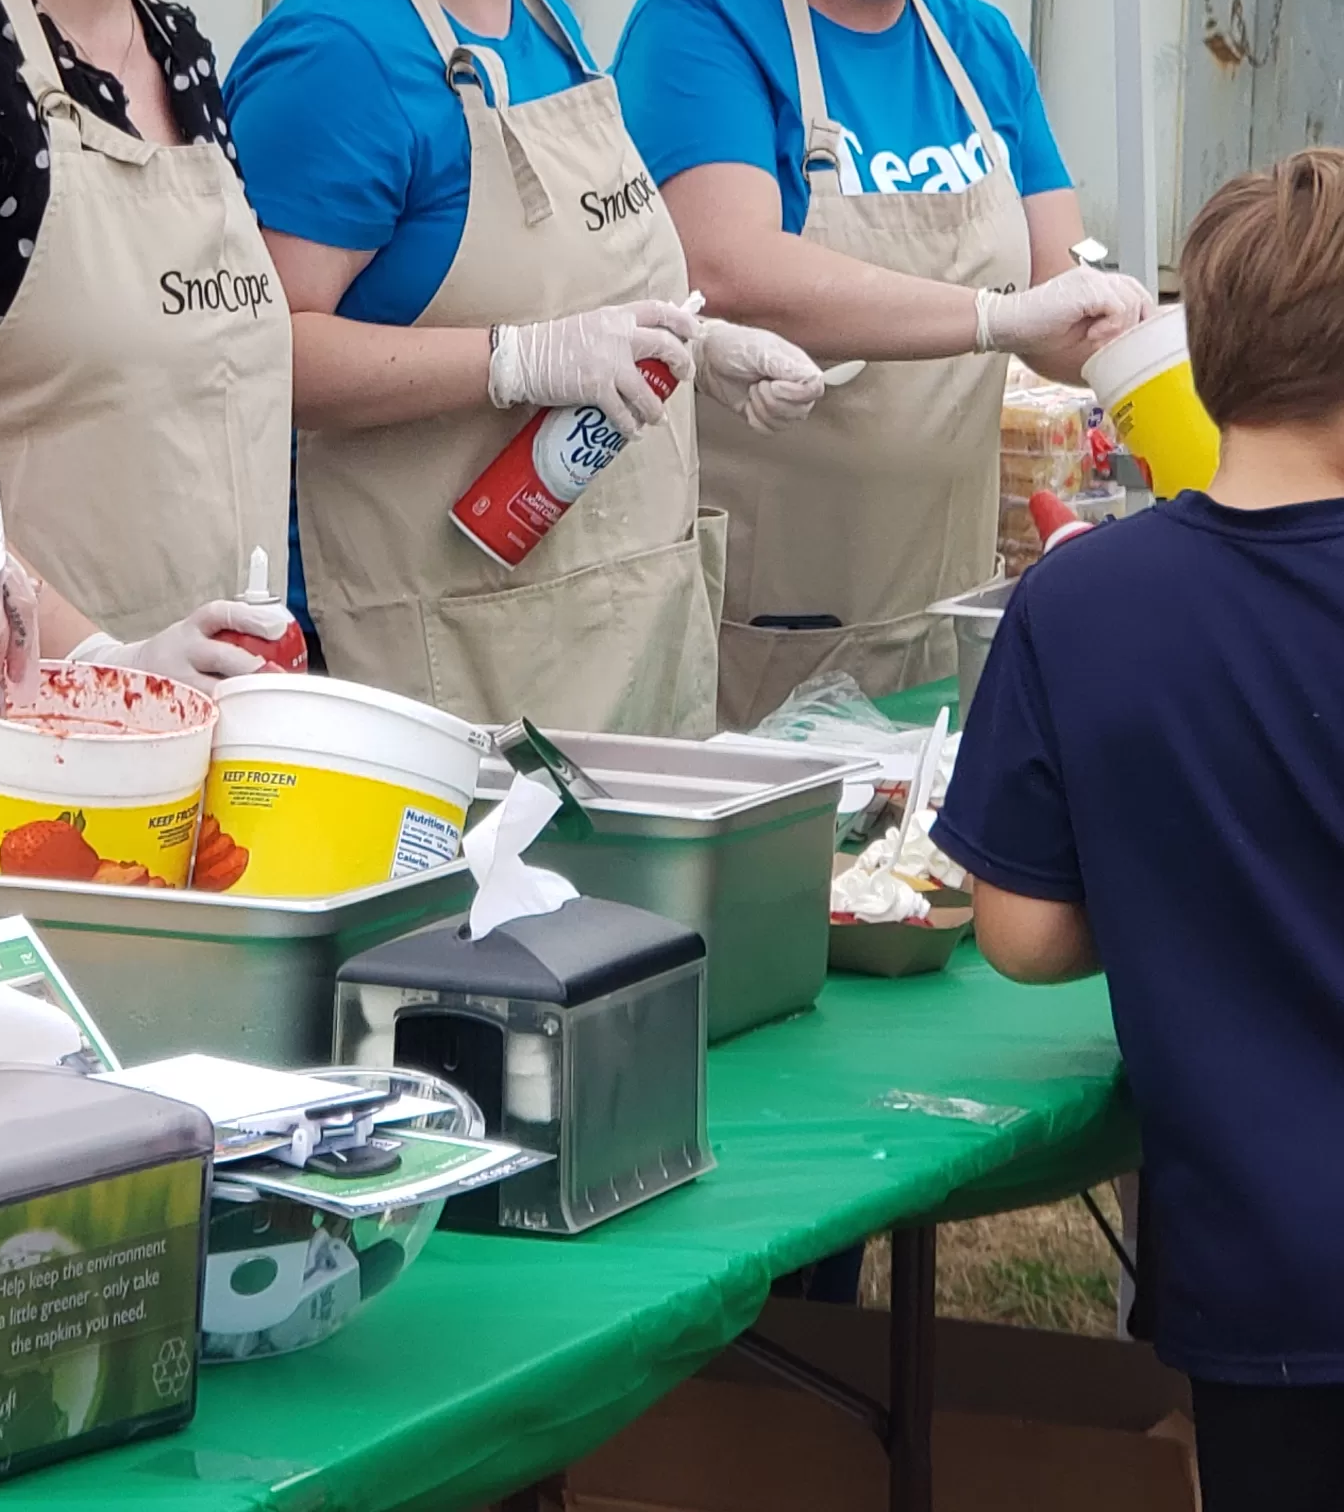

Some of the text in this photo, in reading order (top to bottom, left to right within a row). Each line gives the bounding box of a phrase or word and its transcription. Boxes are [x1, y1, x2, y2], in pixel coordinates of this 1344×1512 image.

[579, 171, 656, 232] SnoCope
[160, 269, 273, 319] SnoCope
[222, 771, 297, 786] KEEP FROZEN
[148, 813, 175, 829] KEEP
[406, 810, 445, 832] Nutrition
[29, 1269, 59, 1291] keep
[63, 1259, 84, 1281] the
[87, 1239, 166, 1274] environment
[9, 1300, 38, 1326] little
[40, 1290, 91, 1323] greener
[103, 1273, 130, 1300] only
[133, 1268, 160, 1291] take
[11, 1333, 32, 1357] the
[36, 1320, 82, 1351] napkins
[86, 1314, 109, 1339] you
